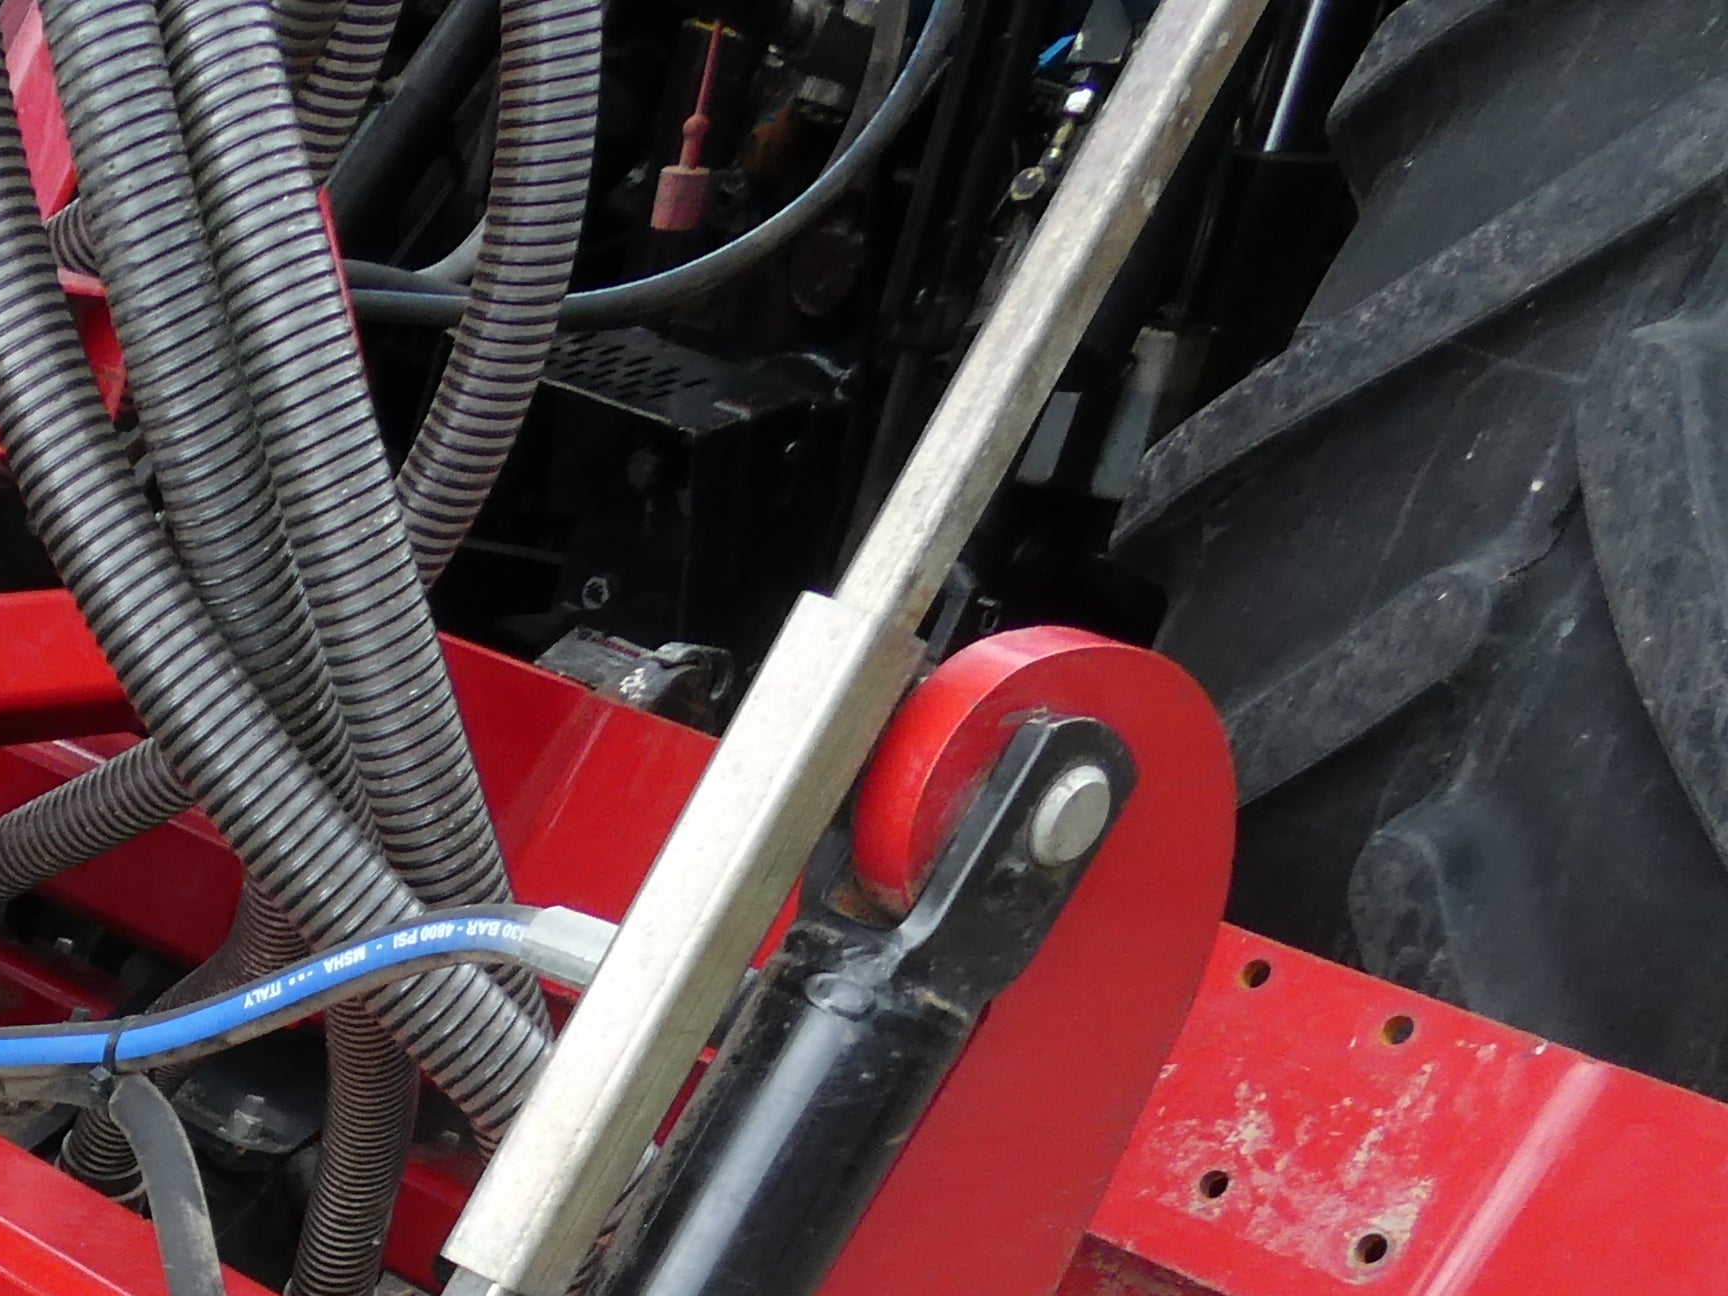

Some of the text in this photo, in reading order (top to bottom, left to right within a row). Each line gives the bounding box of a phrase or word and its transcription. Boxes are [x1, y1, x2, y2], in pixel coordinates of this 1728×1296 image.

[393, 928, 417, 949] PSI
[421, 923, 454, 940] 4800
[465, 920, 501, 937] BAR
[323, 945, 366, 974] MSHA
[243, 980, 283, 1009] ITALY
